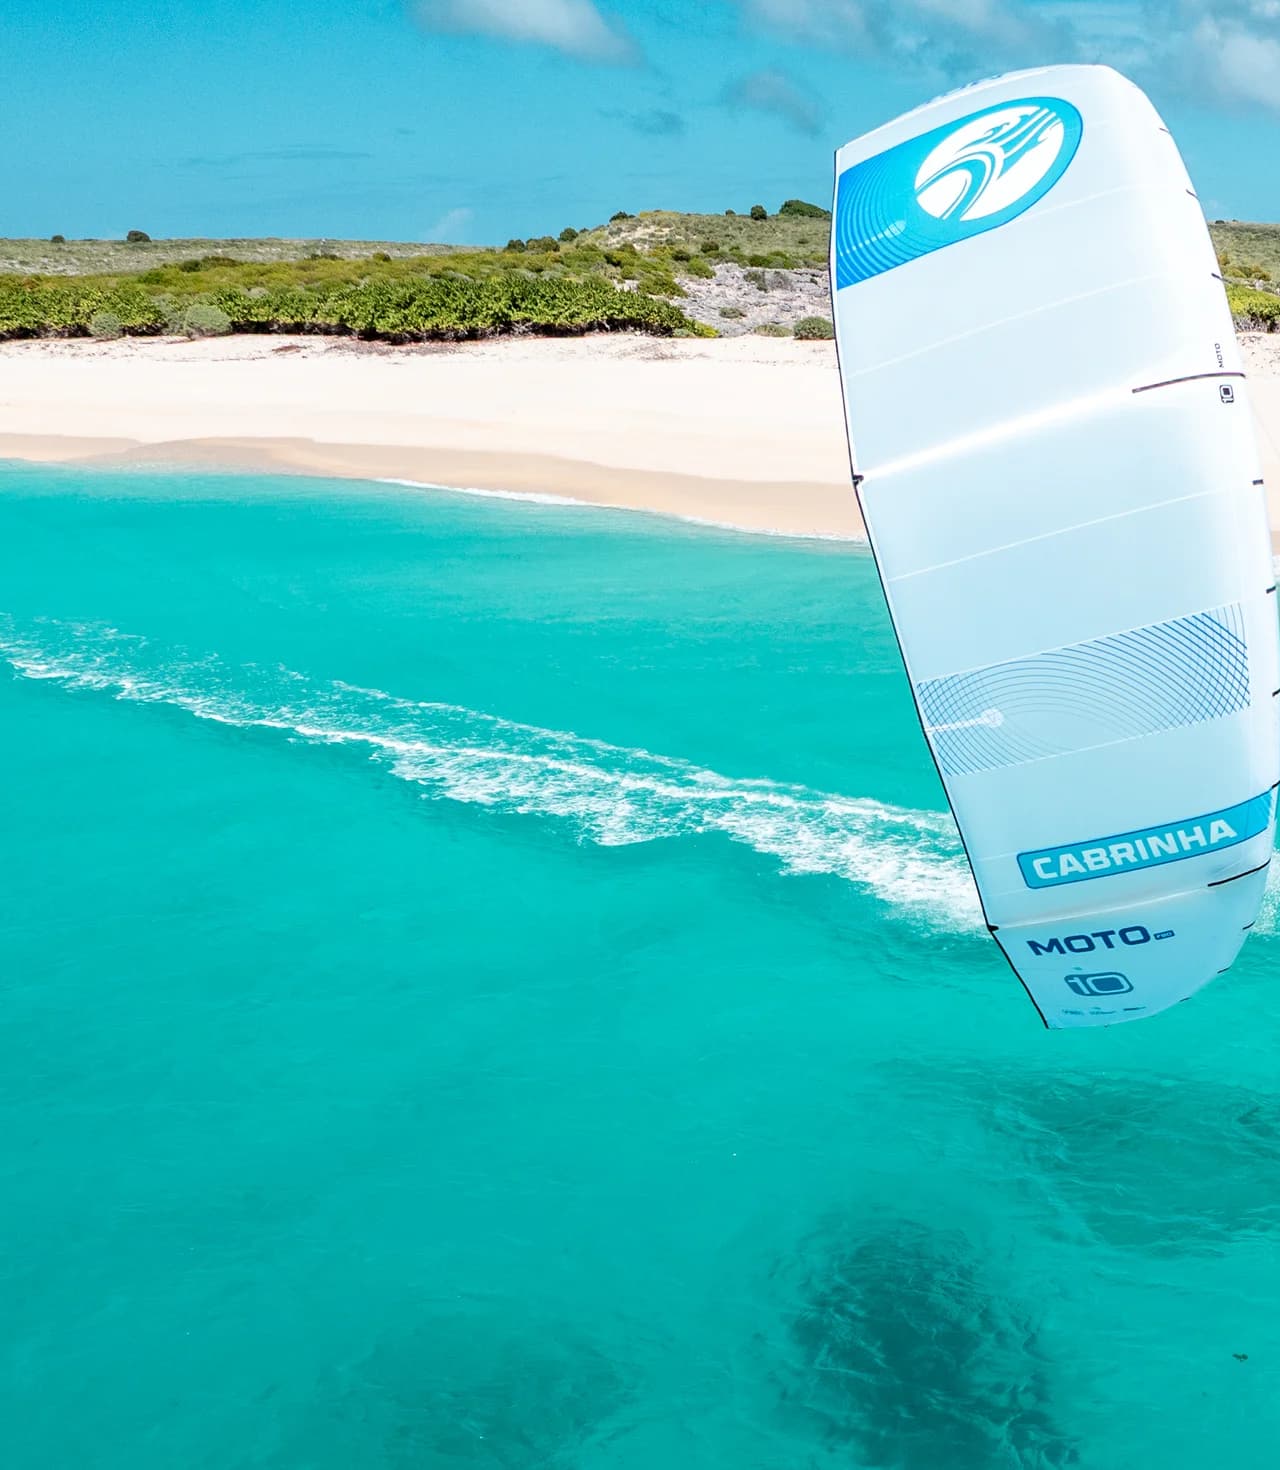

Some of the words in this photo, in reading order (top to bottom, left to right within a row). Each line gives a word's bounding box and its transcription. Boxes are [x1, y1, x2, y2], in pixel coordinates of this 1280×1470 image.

[1214, 342, 1224, 368] MOTO
[1032, 819, 1238, 879] CABRINHA
[1026, 925, 1151, 956] MOTO
[1067, 973, 1131, 995] 10
